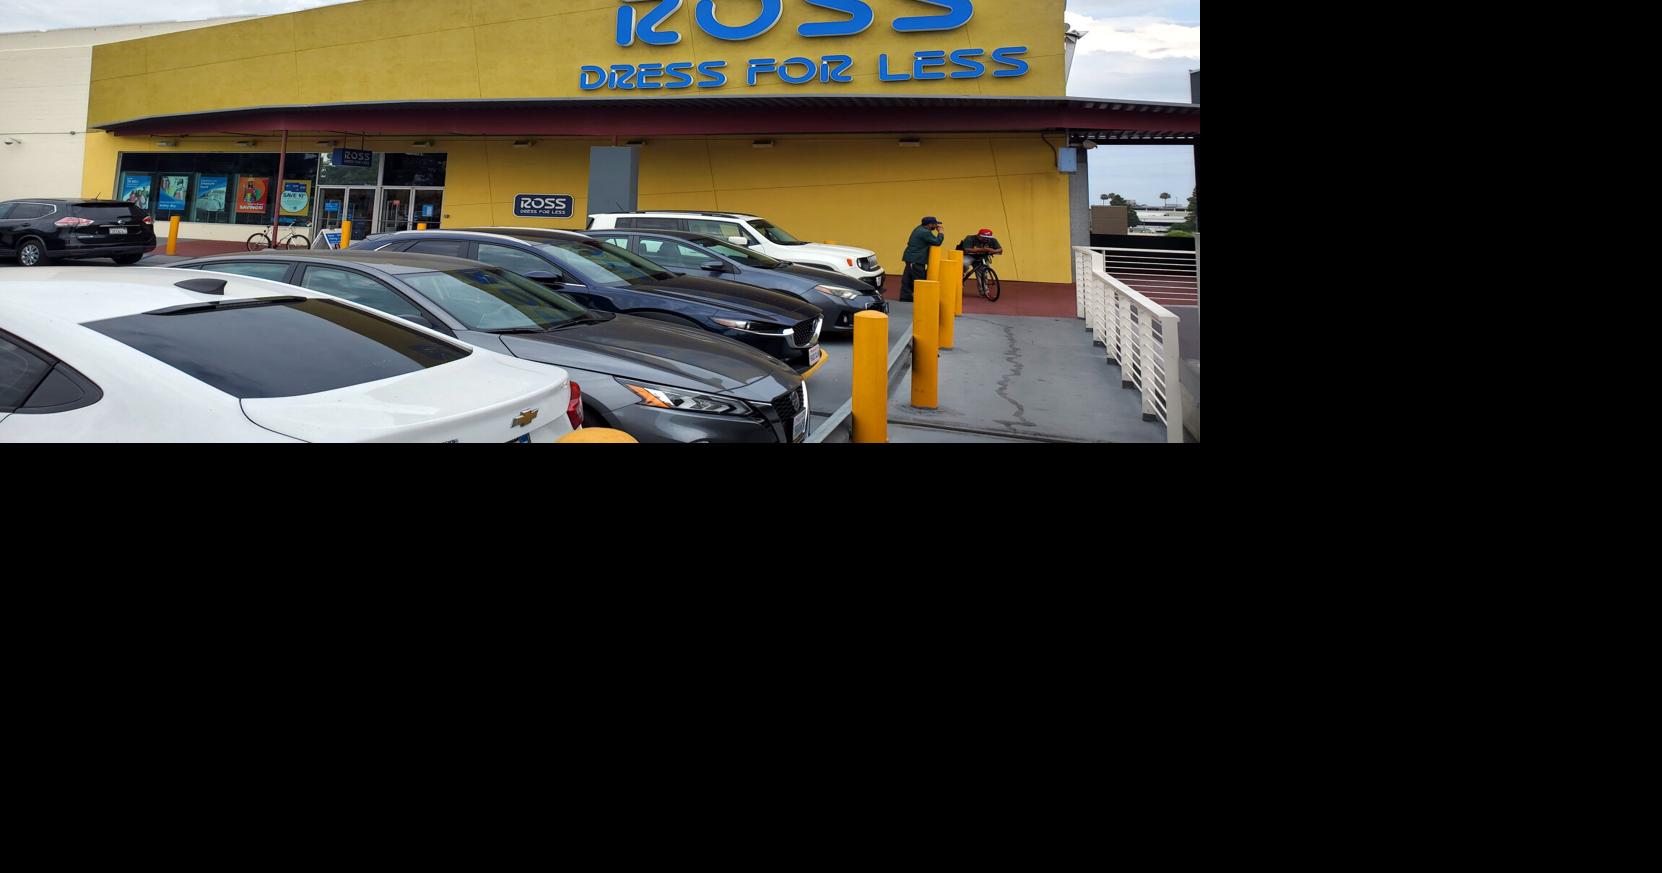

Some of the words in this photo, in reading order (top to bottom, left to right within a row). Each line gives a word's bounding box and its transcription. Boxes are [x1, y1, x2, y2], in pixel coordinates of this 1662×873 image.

[579, 60, 728, 91] DRESS
[746, 54, 853, 86] FOR
[878, 46, 1030, 81] LESS
[344, 151, 370, 161] ROSS
[520, 197, 566, 209] ROSS
